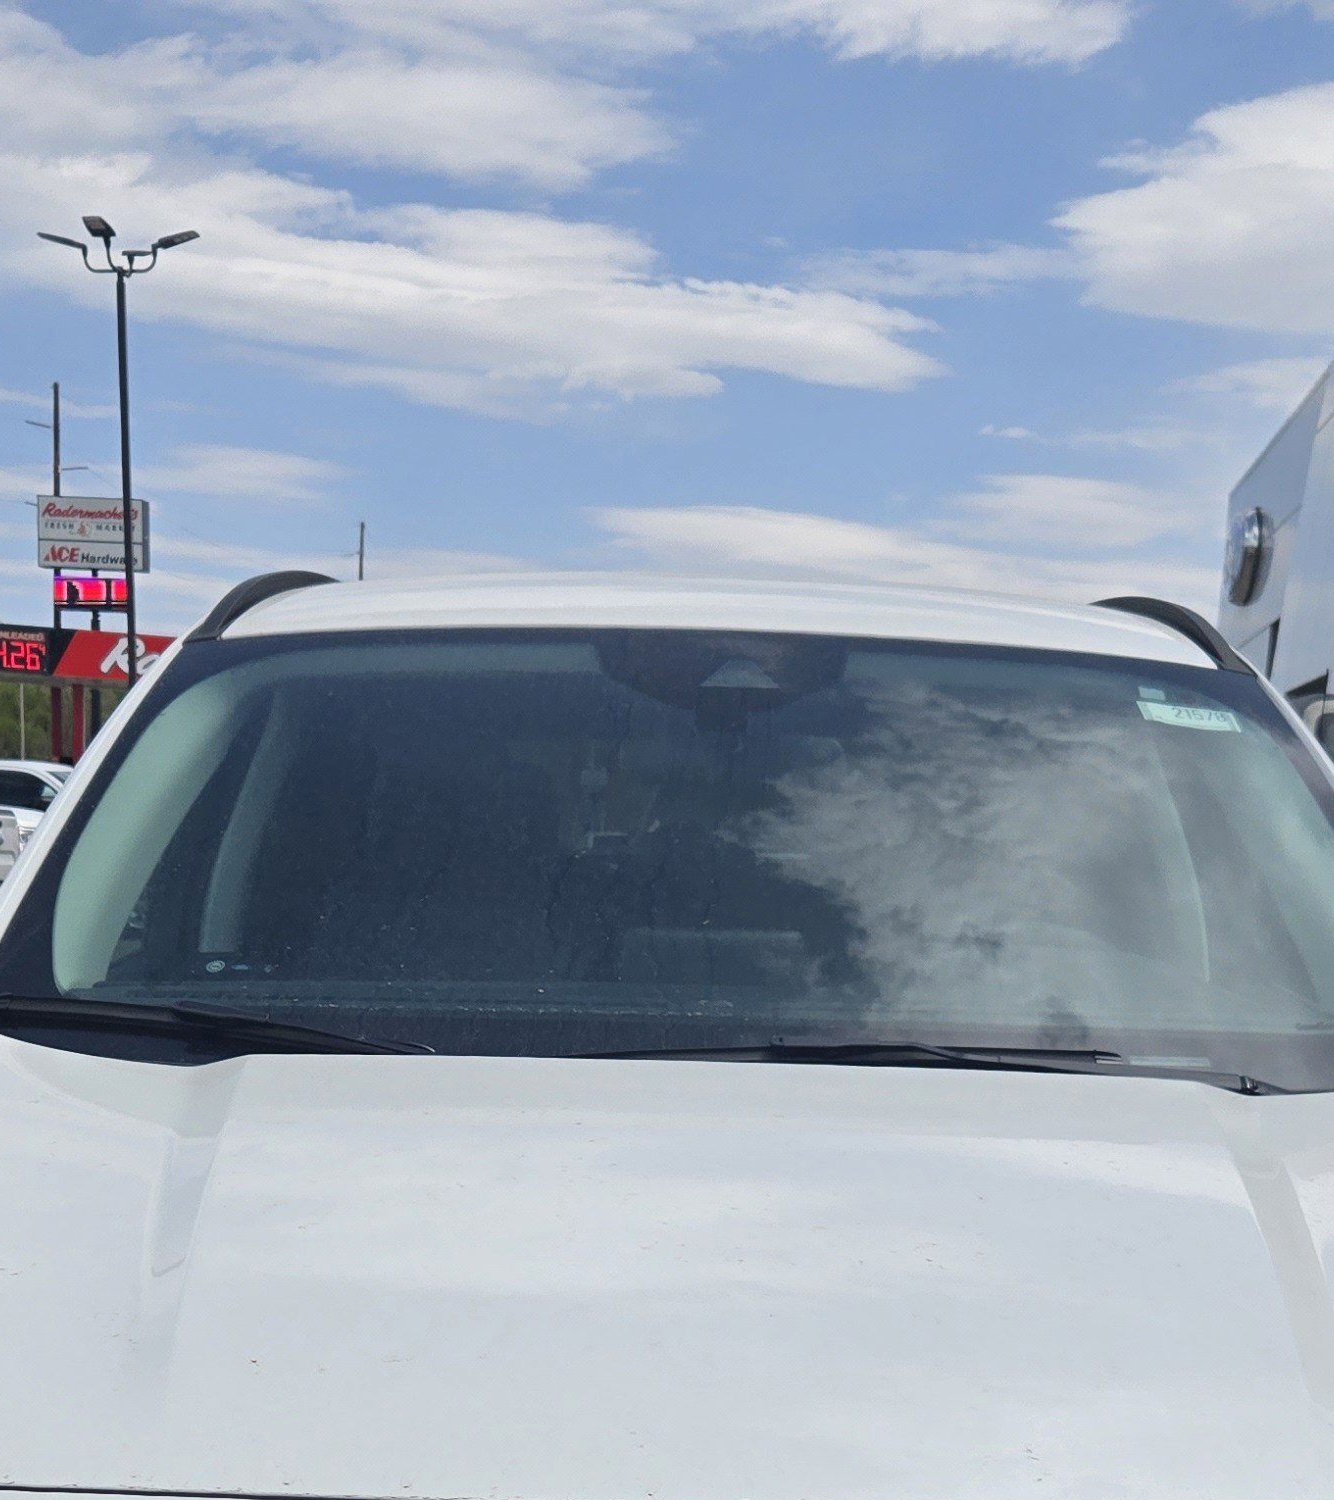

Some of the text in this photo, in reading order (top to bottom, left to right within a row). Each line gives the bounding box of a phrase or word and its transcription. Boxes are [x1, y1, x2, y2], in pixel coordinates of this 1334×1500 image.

[42, 502, 138, 520] Radermache's
[96, 523, 135, 532] MARKT
[44, 544, 138, 566] ACE Hardwae
